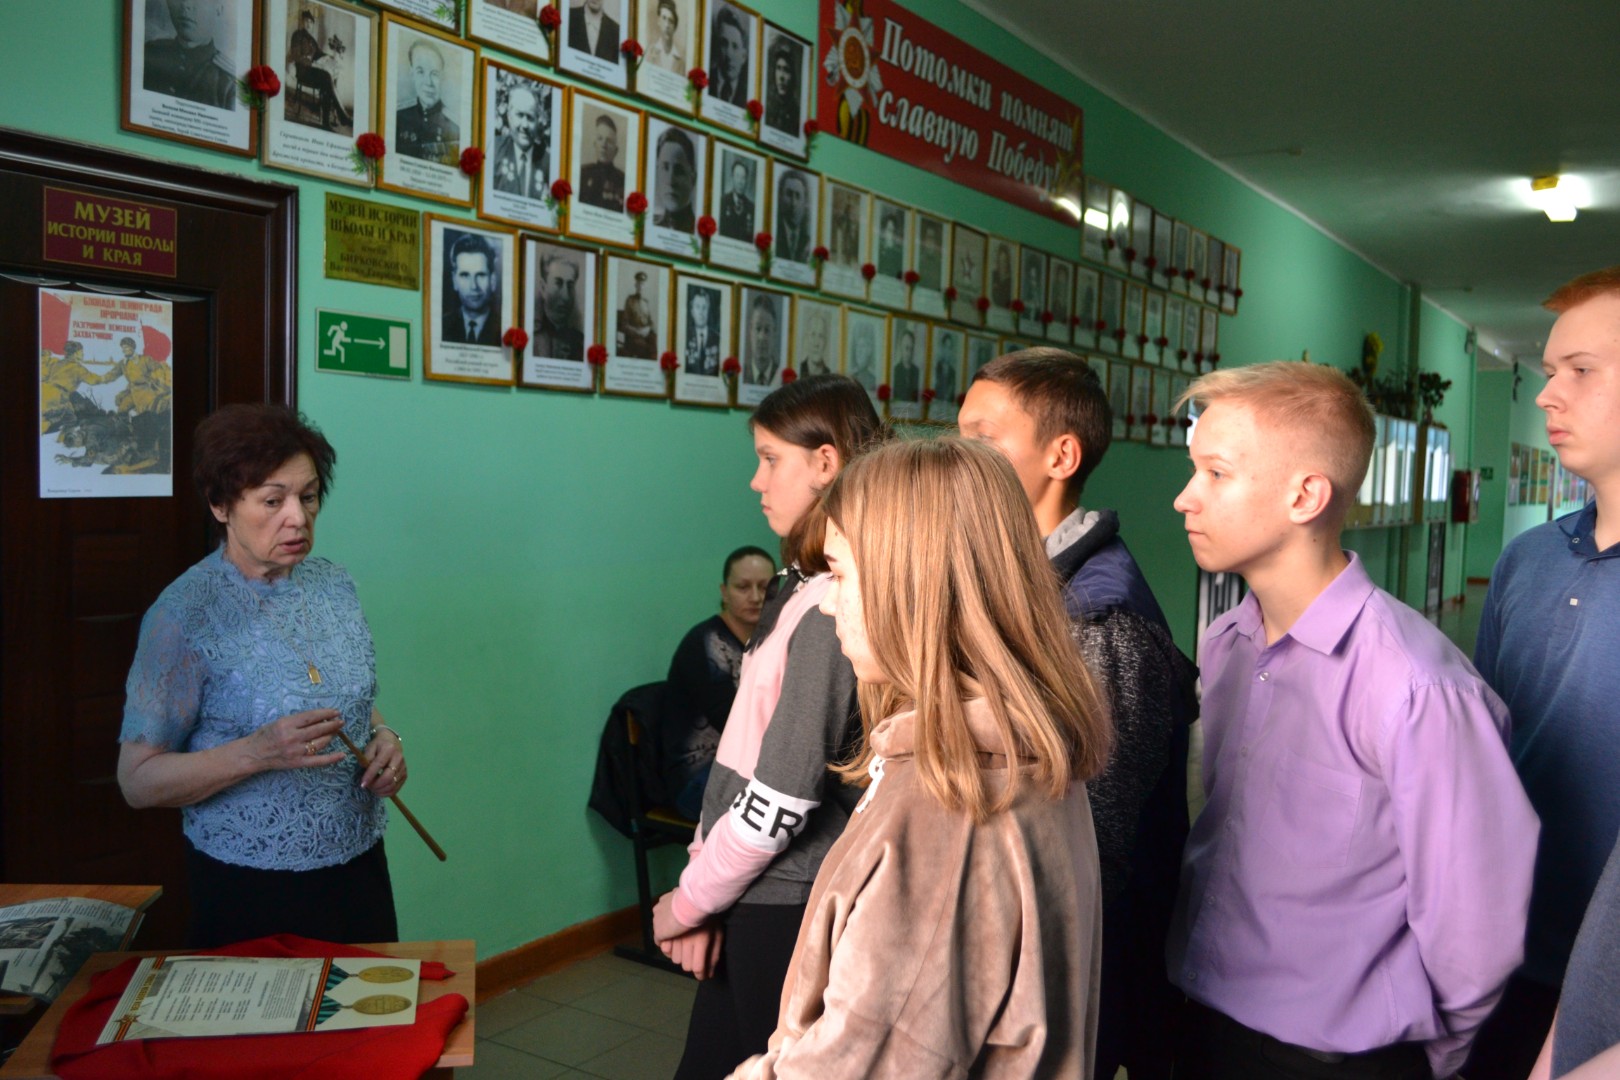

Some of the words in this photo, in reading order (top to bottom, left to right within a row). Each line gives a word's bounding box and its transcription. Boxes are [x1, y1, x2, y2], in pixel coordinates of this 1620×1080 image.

[880, 17, 992, 111] Потомки
[1000, 91, 1074, 151] помнят
[878, 91, 979, 164] славную
[987, 130, 1060, 201] Победу!
[74, 201, 151, 231] МУЗЕЙ
[329, 199, 365, 219] МУЗЕЙ
[368, 207, 418, 229] ИСТОРИИ
[47, 221, 116, 244] ИСТОРИИ
[120, 232, 174, 253] ШКОЛЫ
[330, 217, 375, 238] ШКОЛЫ
[377, 227, 386, 241] И
[389, 229, 416, 246] КРАЯ
[82, 244, 95, 259] И
[103, 247, 142, 266] КРАЯ
